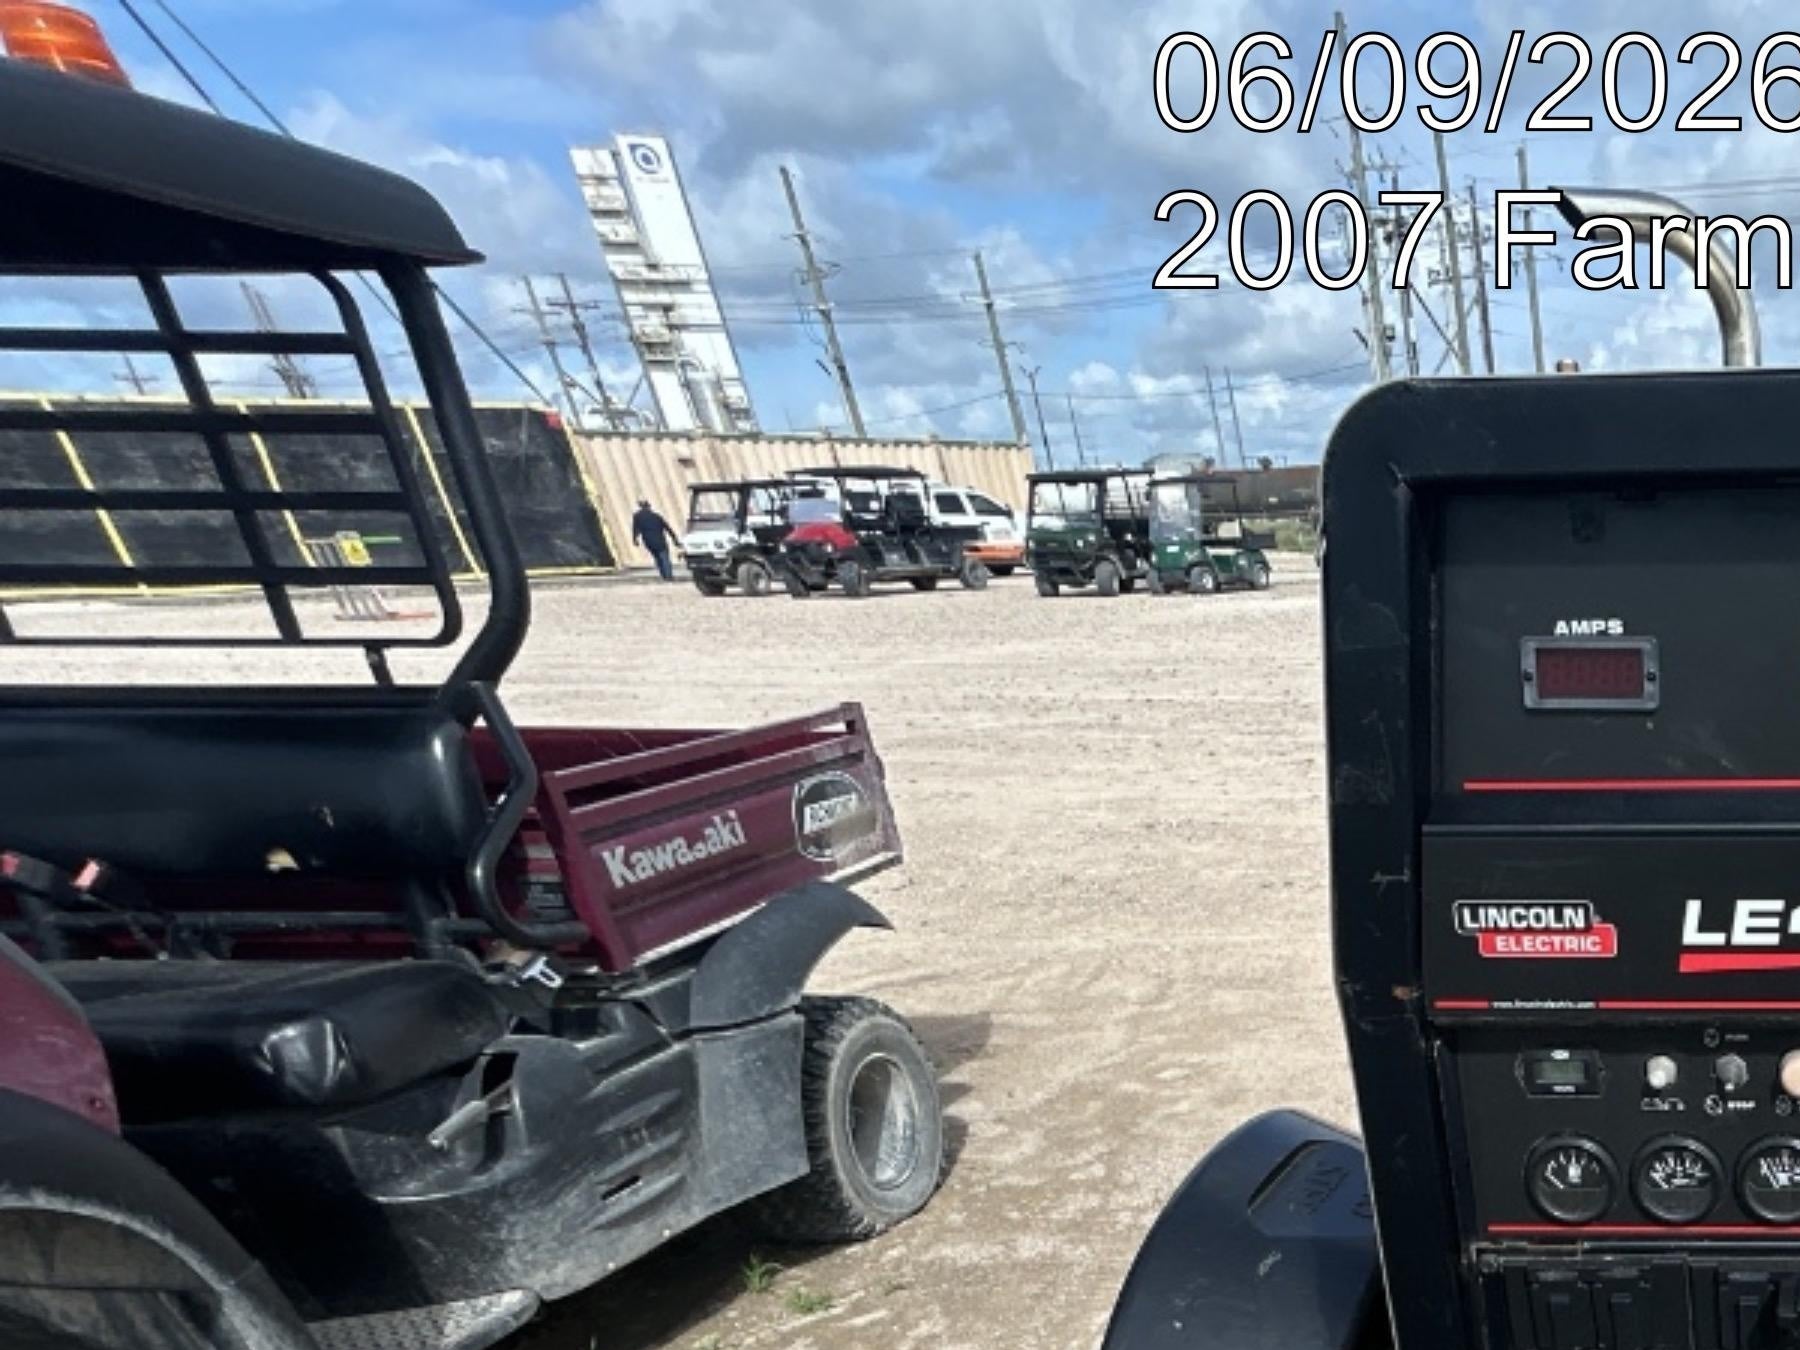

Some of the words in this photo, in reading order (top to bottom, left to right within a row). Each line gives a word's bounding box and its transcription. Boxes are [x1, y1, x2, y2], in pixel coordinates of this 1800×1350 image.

[1554, 618, 1624, 636] AMPS
[602, 809, 747, 890] Kawasaki
[1463, 906, 1586, 930] LINCOLN
[1494, 934, 1602, 953] ELECTRIC
